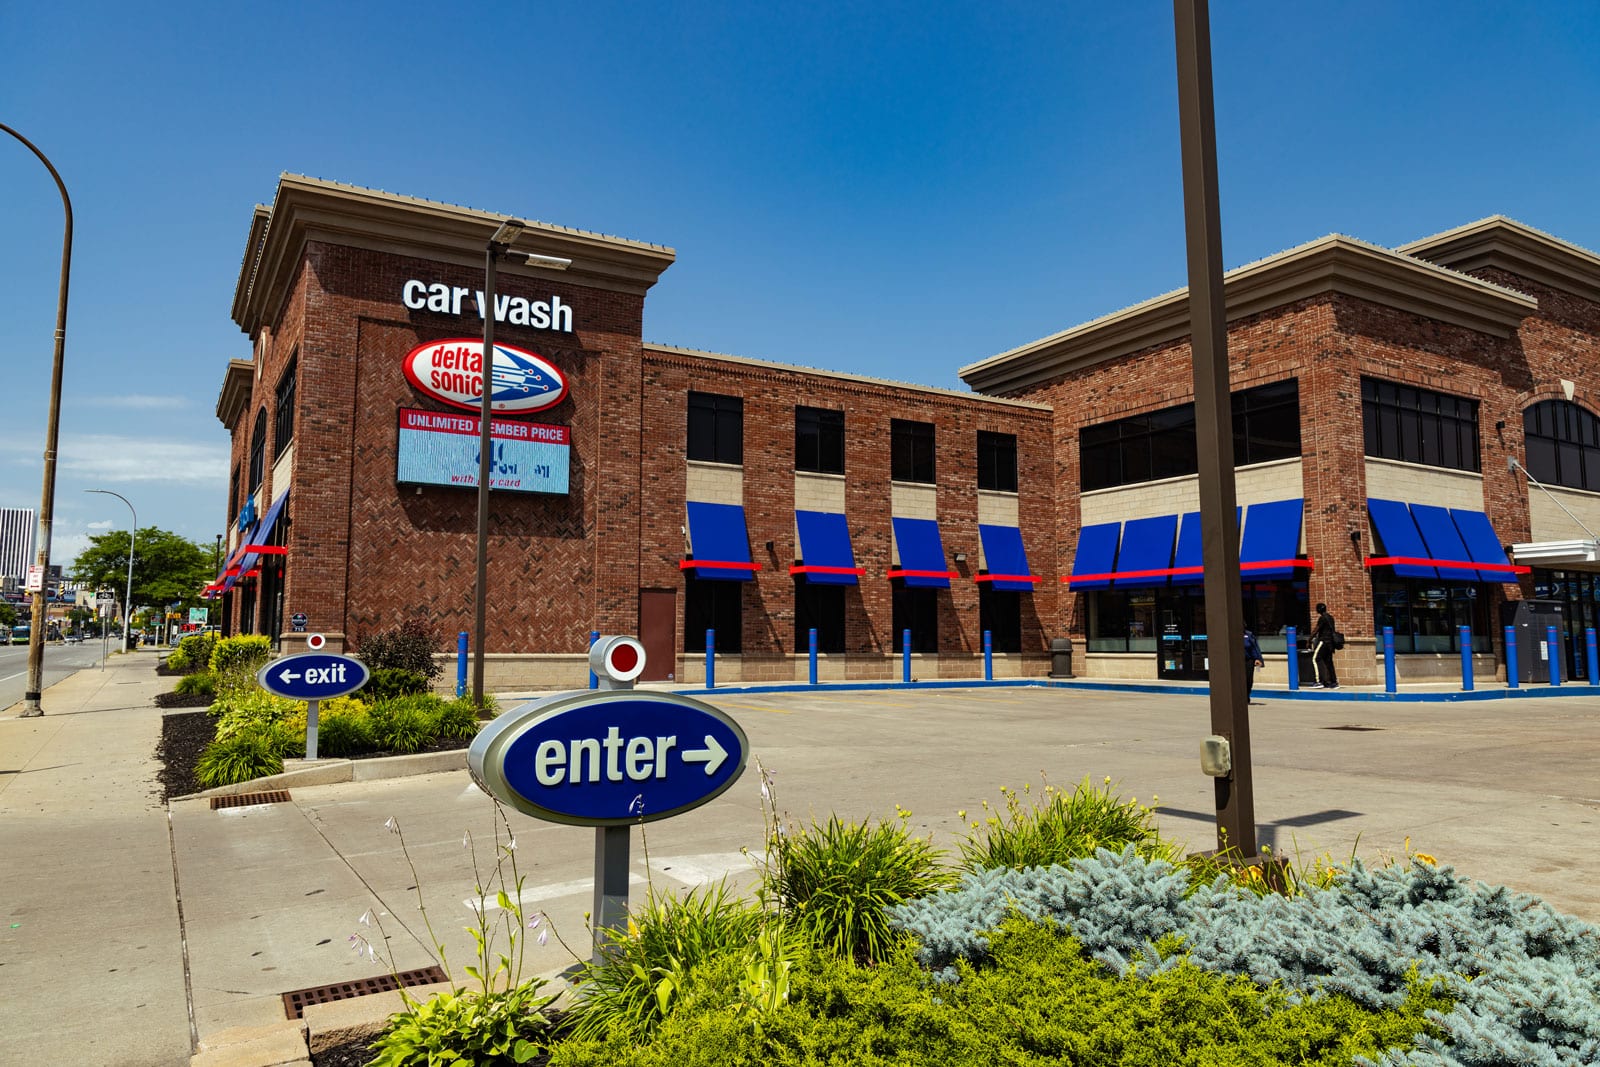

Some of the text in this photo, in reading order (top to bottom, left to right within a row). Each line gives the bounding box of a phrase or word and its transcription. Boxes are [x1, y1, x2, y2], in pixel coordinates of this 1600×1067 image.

[402, 279, 573, 333] car wash
[431, 345, 484, 374] delta
[430, 369, 483, 397] sonic
[407, 413, 474, 432] UNLIMITED
[531, 427, 564, 441] PRICE
[451, 474, 474, 483] with
[498, 479, 521, 487] card
[304, 663, 347, 685] exit
[534, 726, 677, 787] enter
